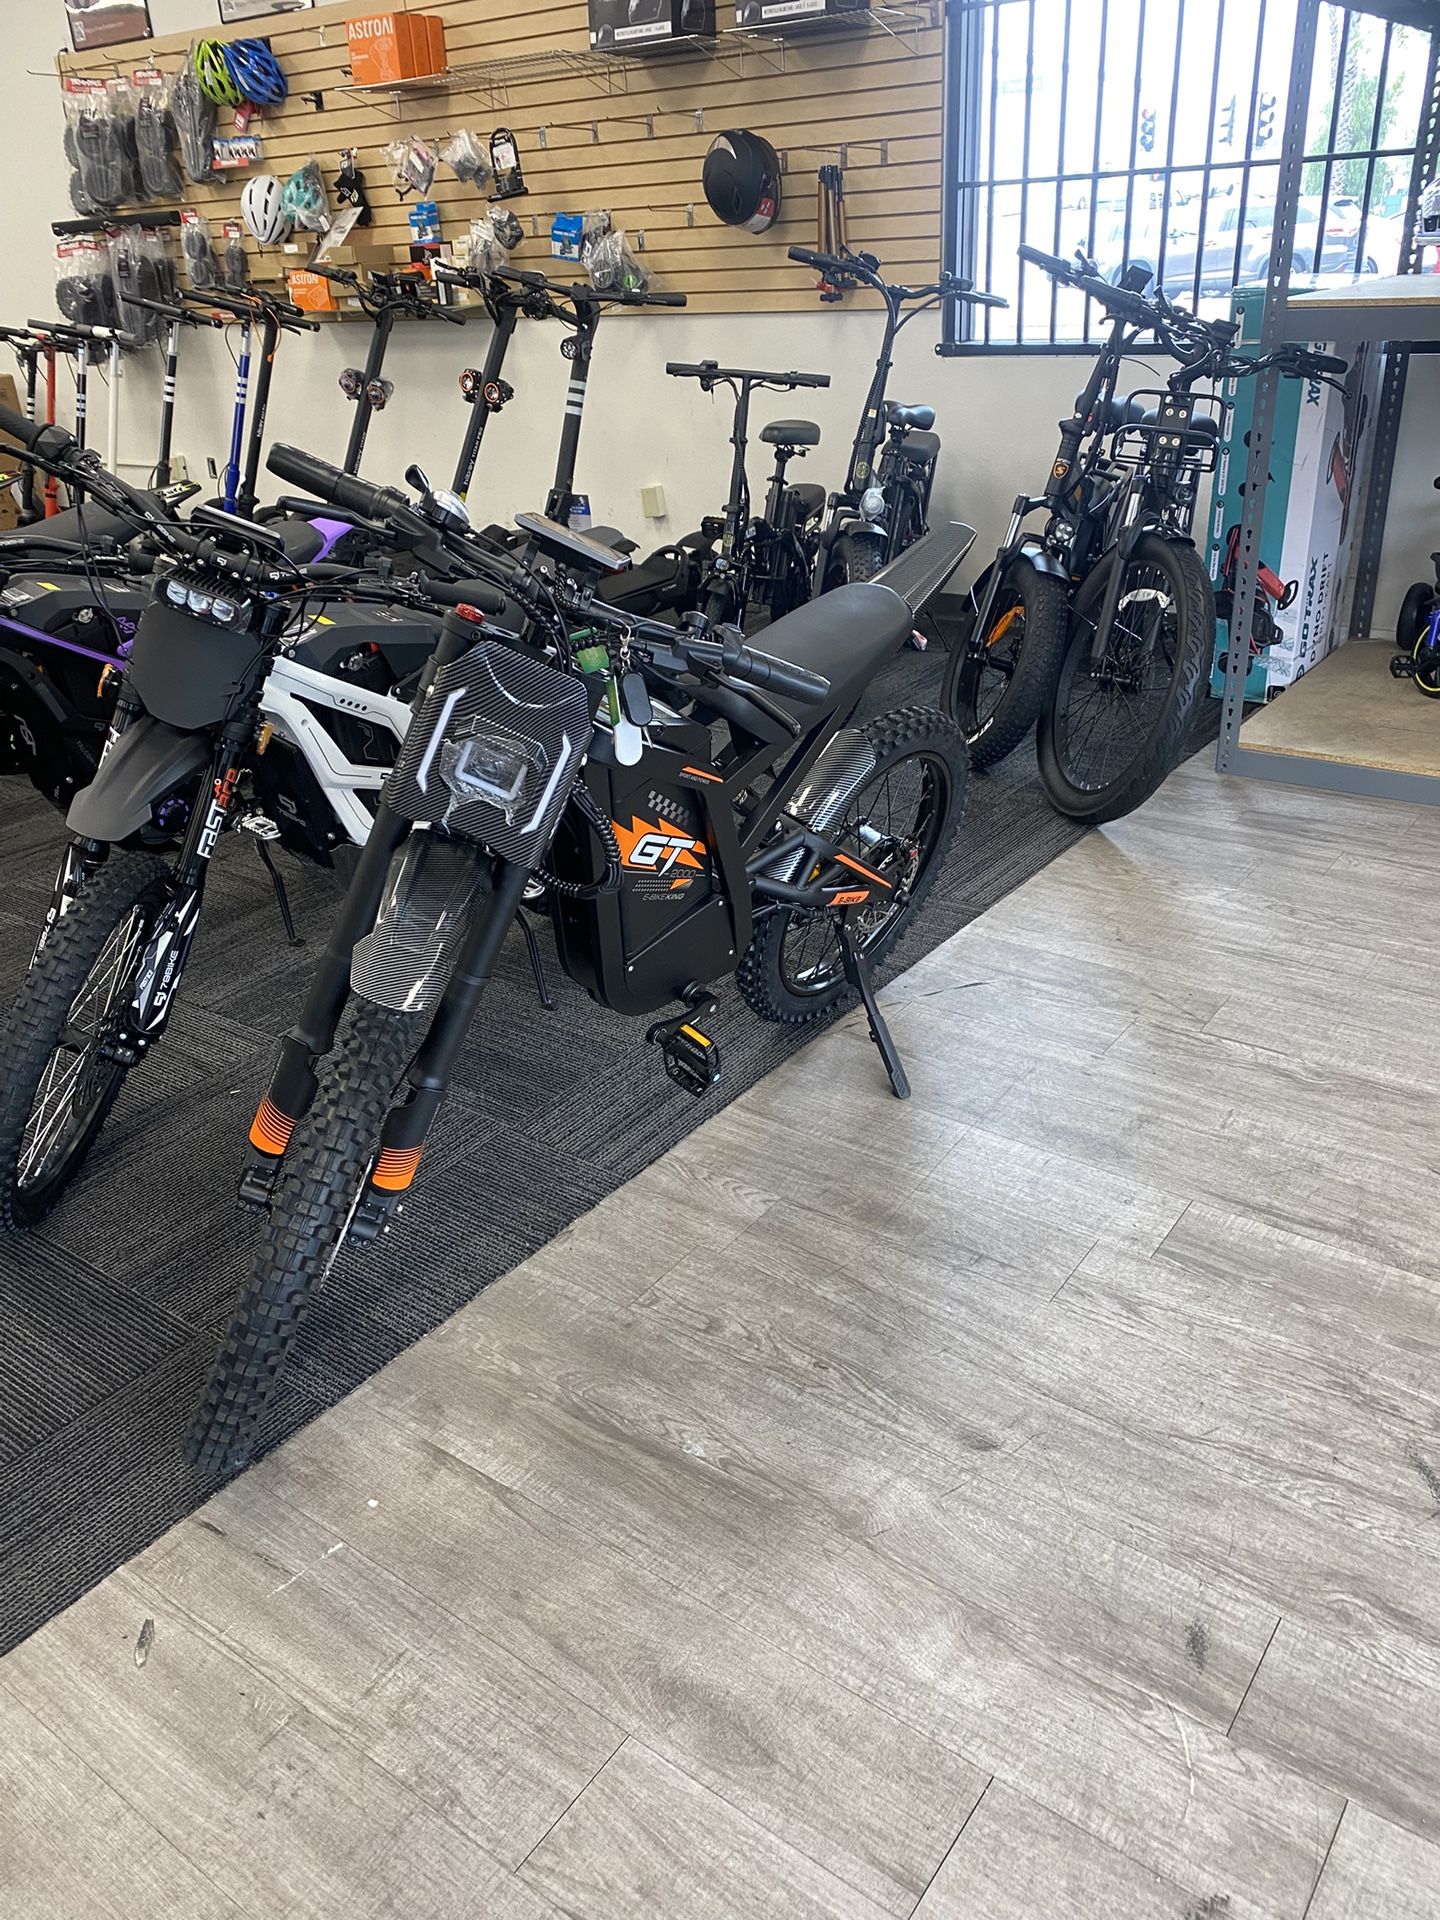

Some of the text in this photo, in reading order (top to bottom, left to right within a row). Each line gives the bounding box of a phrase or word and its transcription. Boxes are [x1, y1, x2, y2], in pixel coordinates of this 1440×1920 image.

[1318, 552, 1330, 604] DRIFT
[630, 833, 696, 878] GT
[670, 869, 696, 878] 2000
[159, 950, 179, 990] 79BIKE
